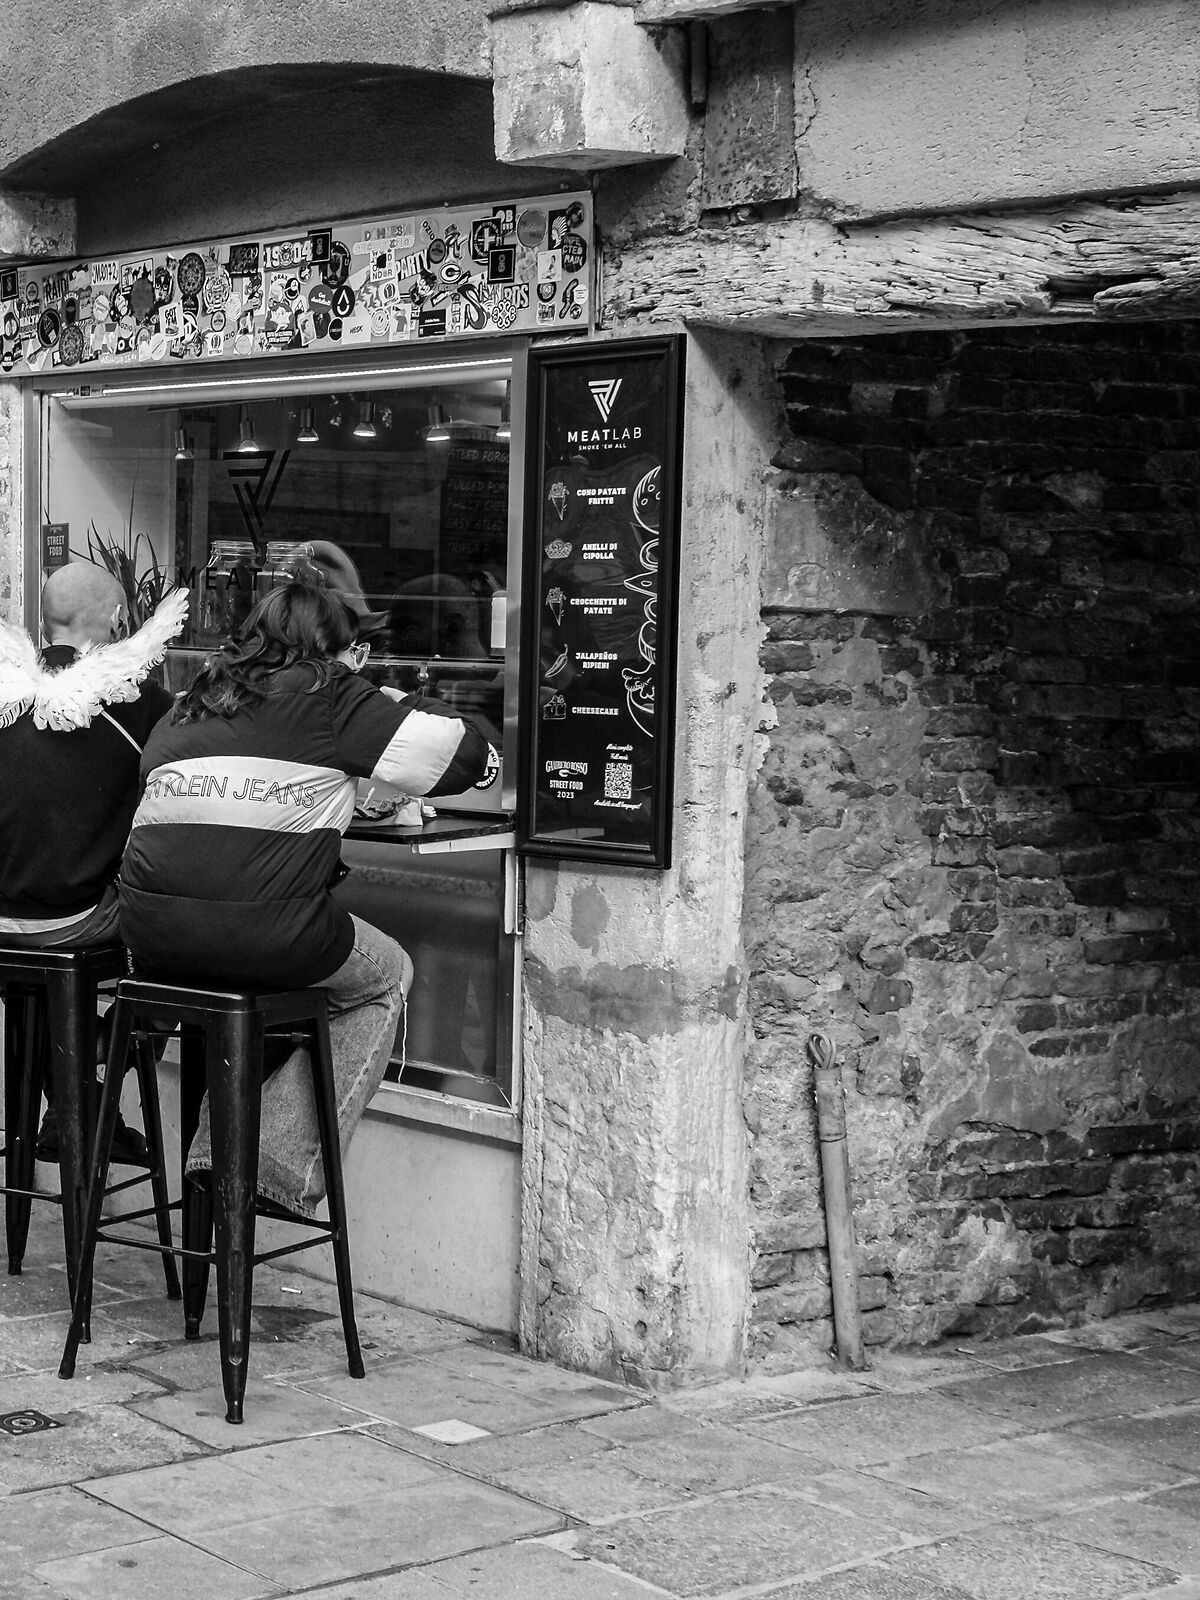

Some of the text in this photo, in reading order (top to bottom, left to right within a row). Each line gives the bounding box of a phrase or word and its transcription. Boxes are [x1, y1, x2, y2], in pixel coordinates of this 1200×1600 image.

[567, 426, 643, 443] MEATLAB
[576, 487, 627, 497] CONO PATATE
[588, 497, 614, 505] FRITTE
[46, 535, 65, 546] STREET
[49, 546, 63, 556] FOOD
[581, 543, 618, 551] ANELLI DI
[583, 552, 614, 560] CIPOLLA
[570, 598, 627, 606] CROCCHETTE DI
[583, 607, 613, 615] PATATE
[575, 651, 618, 661] JALAPEÑOS
[582, 661, 610, 670] RIPIENI
[571, 706, 619, 716] CHEESECAKE
[549, 780, 584, 791] STREET FOOD
[163, 774, 228, 799] KLEIN
[233, 777, 318, 809] JEANS
[557, 791, 575, 799] 2023
